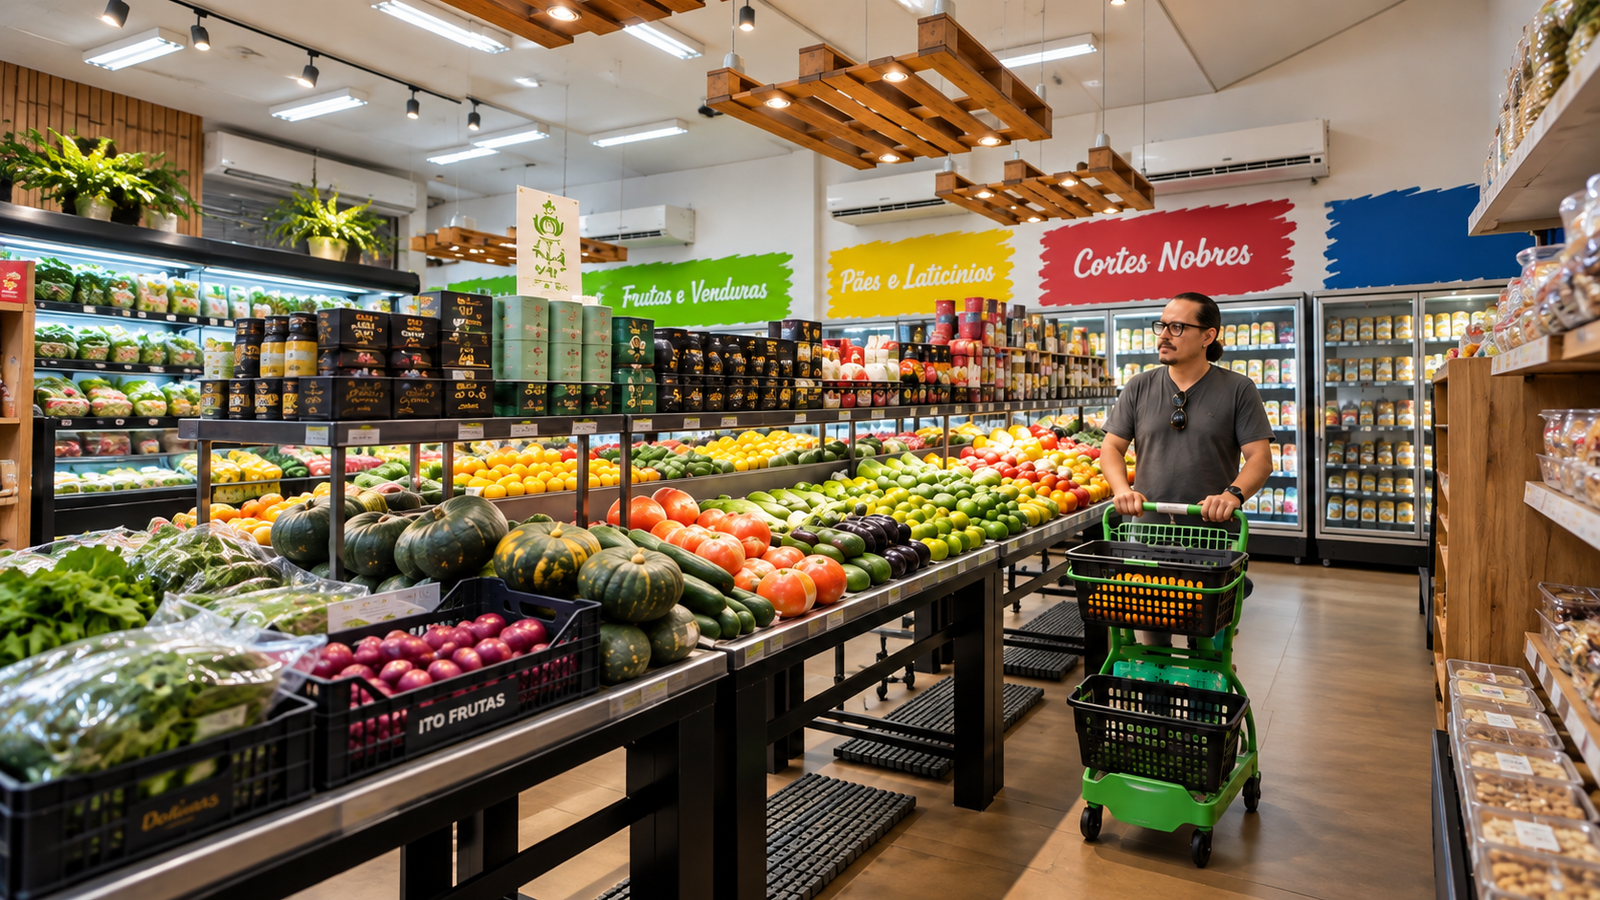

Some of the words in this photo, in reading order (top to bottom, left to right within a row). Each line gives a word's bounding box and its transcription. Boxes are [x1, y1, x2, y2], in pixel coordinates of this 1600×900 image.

[1073, 246, 1151, 279] Cortes
[1157, 237, 1254, 273] Nobres
[887, 273, 900, 290] e
[901, 262, 997, 290] Laticinios
[621, 284, 672, 309] Frutas
[675, 289, 686, 305] e
[418, 712, 446, 735] ITO
[448, 692, 506, 725] FRUTAS
